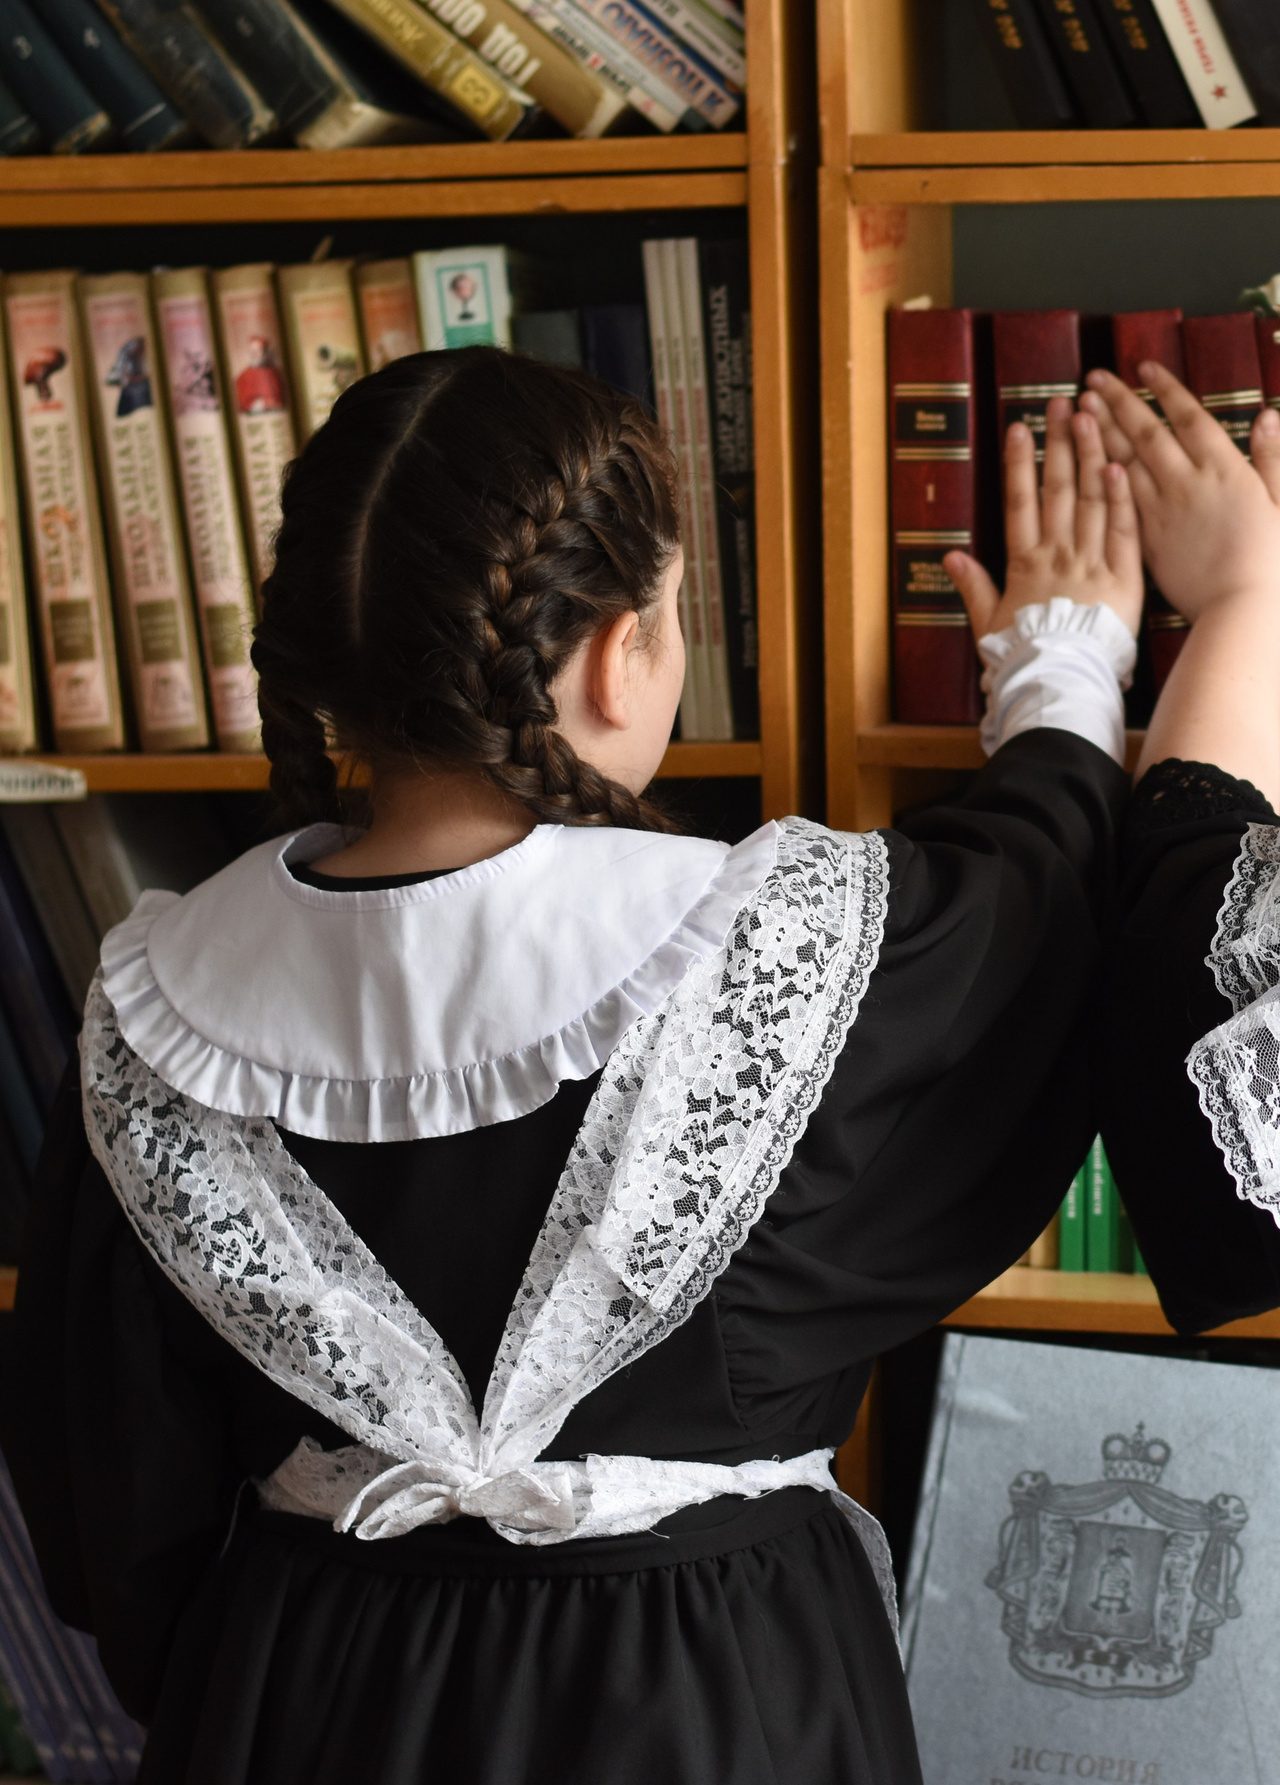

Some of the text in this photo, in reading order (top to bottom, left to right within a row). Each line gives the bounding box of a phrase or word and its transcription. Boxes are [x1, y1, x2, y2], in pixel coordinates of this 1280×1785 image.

[480, 22, 542, 86] ГОД
[601, 1, 704, 97] ПОЗНАЮ
[701, 89, 725, 115] Я
[1009, 1745, 1162, 1785] ИСТОРИЯ
